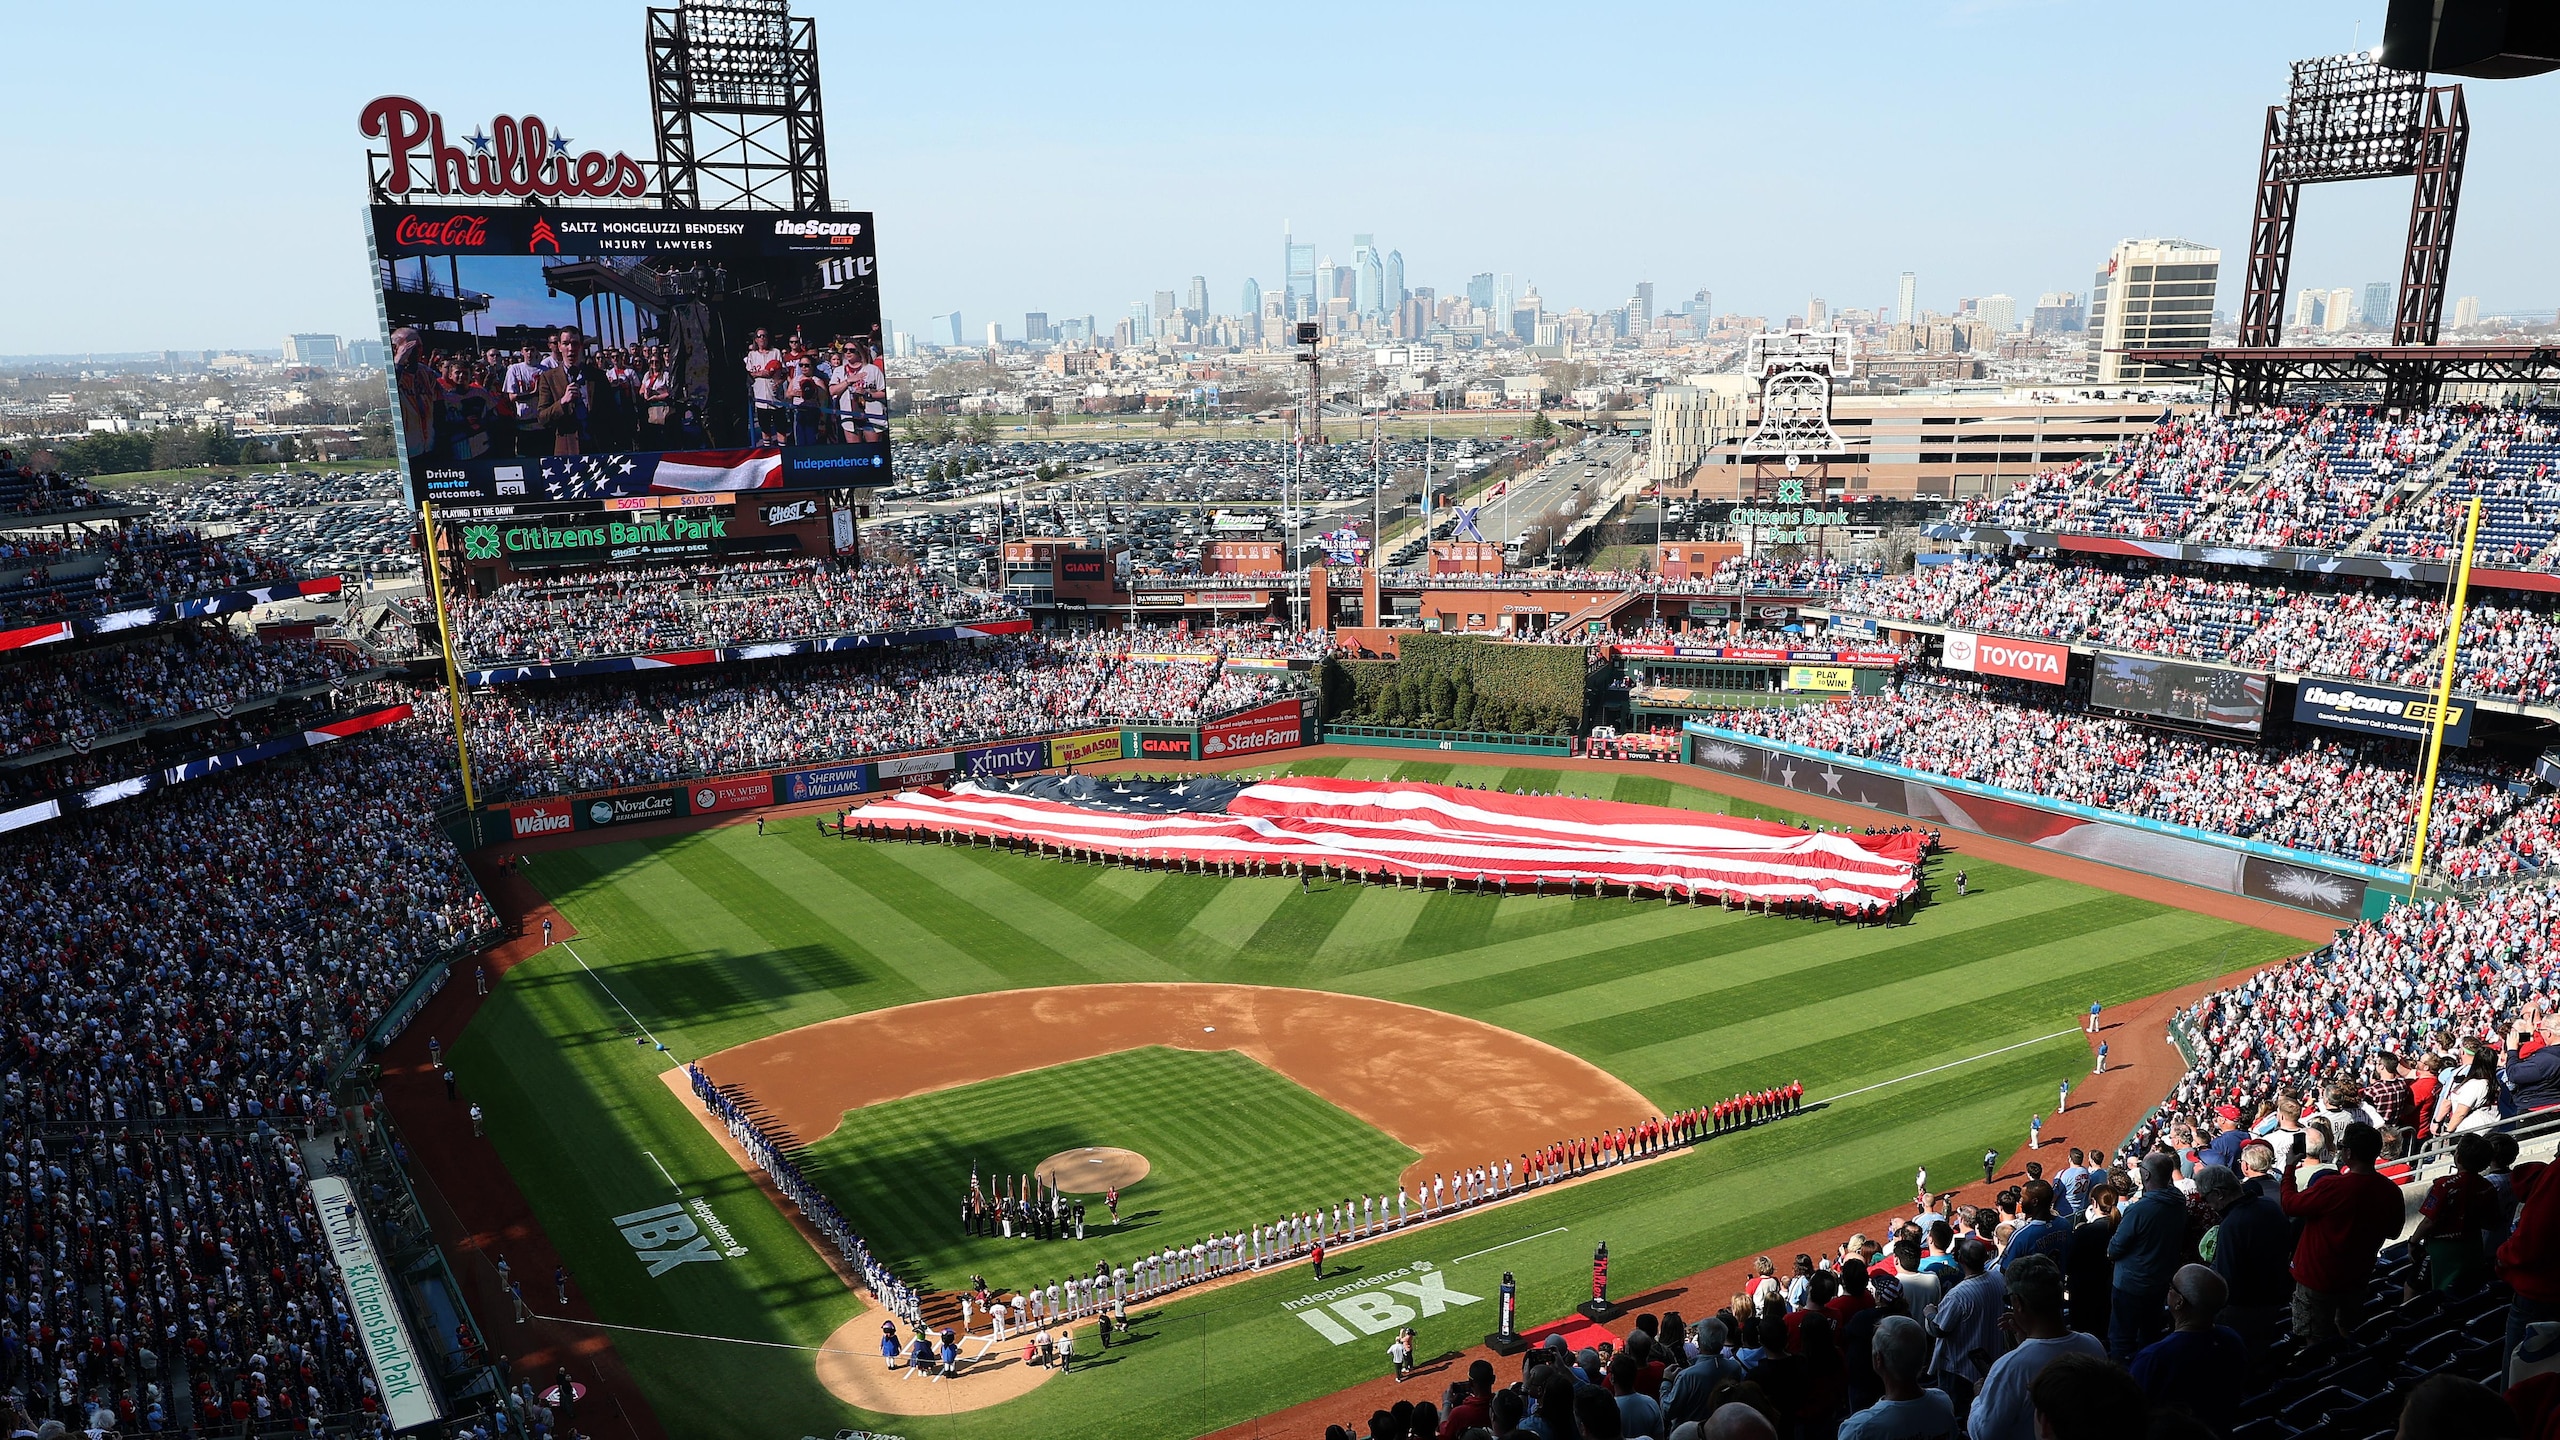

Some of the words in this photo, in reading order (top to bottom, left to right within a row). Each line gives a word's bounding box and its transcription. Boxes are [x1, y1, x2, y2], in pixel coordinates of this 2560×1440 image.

[358, 95, 648, 199] Phillies
[396, 214, 489, 246] Coca-Cola
[561, 222, 597, 233] SALTZ
[603, 222, 680, 234] MONGELUZZI
[685, 223, 744, 235] BENDESKY
[774, 219, 861, 235] theScore
[600, 239, 646, 249] INJURY
[656, 240, 713, 250] LAWYERS
[821, 256, 874, 290] Lite
[793, 456, 869, 470] Independence
[426, 468, 466, 480] Driving
[427, 480, 469, 489] smarter
[429, 489, 485, 499] outcomes.
[681, 496, 715, 505] $61,020
[442, 508, 471, 519] PLAYING)
[473, 508, 482, 516] BY
[482, 507, 495, 516] THE
[769, 500, 807, 526] GHOST
[1212, 509, 1268, 525] Fitzpatrick
[1729, 508, 1800, 525] Citizens
[1803, 507, 1850, 525] Bank
[505, 527, 605, 551] Citizens
[610, 519, 671, 544] Bank
[674, 515, 727, 540] Park
[1768, 528, 1807, 544] Park
[653, 546, 685, 554] ENERGY
[1320, 540, 1333, 549] ALL
[1334, 540, 1350, 549] STAR
[1351, 540, 1370, 549] GAME
[1065, 564, 1100, 572] GIANT
[1631, 647, 1665, 655] Budweiser
[1742, 651, 1778, 659] Budweiser
[1792, 652, 1831, 660] #HITTHEBUDS
[1980, 645, 2059, 674] TOYOTA
[1826, 679, 1847, 687] WIN!
[2304, 687, 2404, 715] theScore
[1220, 722, 1232, 730] good
[1232, 720, 1253, 728] neighbor,
[2318, 712, 2344, 723] Gambling
[2343, 716, 2369, 727] Problem?
[2370, 720, 2381, 728] Call
[1142, 740, 1190, 752] GIANT
[1439, 741, 1452, 750] 401
[893, 758, 941, 774] Yuengling
[972, 748, 1036, 774] xfinity
[719, 772, 760, 781] ASPLUNDH
[767, 766, 807, 775] ASPLUNDH
[668, 778, 710, 788] ASPLUNDH
[808, 770, 858, 785] SHERWIN
[902, 773, 933, 785] LAGER
[616, 784, 660, 794] ASPLUNDH
[719, 788, 737, 799] F.W.
[739, 784, 768, 796] WEBB
[564, 791, 609, 801] ASPLUNDH
[730, 794, 757, 803] COMPANY
[2003, 790, 2033, 802] Independence
[510, 798, 555, 808] ASPLUNDH
[614, 797, 673, 813] NovaCare
[615, 808, 672, 821] REHABILITATION
[2098, 811, 2131, 823] Independence
[515, 815, 571, 834] Wawa
[2205, 833, 2240, 846] Independence
[2320, 857, 2359, 872] Independence
[2073, 1181, 2089, 1195] 20
[689, 1196, 738, 1248] Independence
[612, 1202, 723, 1278] IBX
[1592, 1257, 1609, 1298] Phillies
[1280, 1266, 1412, 1311] Independence
[350, 1276, 388, 1330] Citizens
[1296, 1270, 1485, 1346] IBX
[368, 1324, 409, 1365] Bank
[382, 1361, 421, 1399] Park
